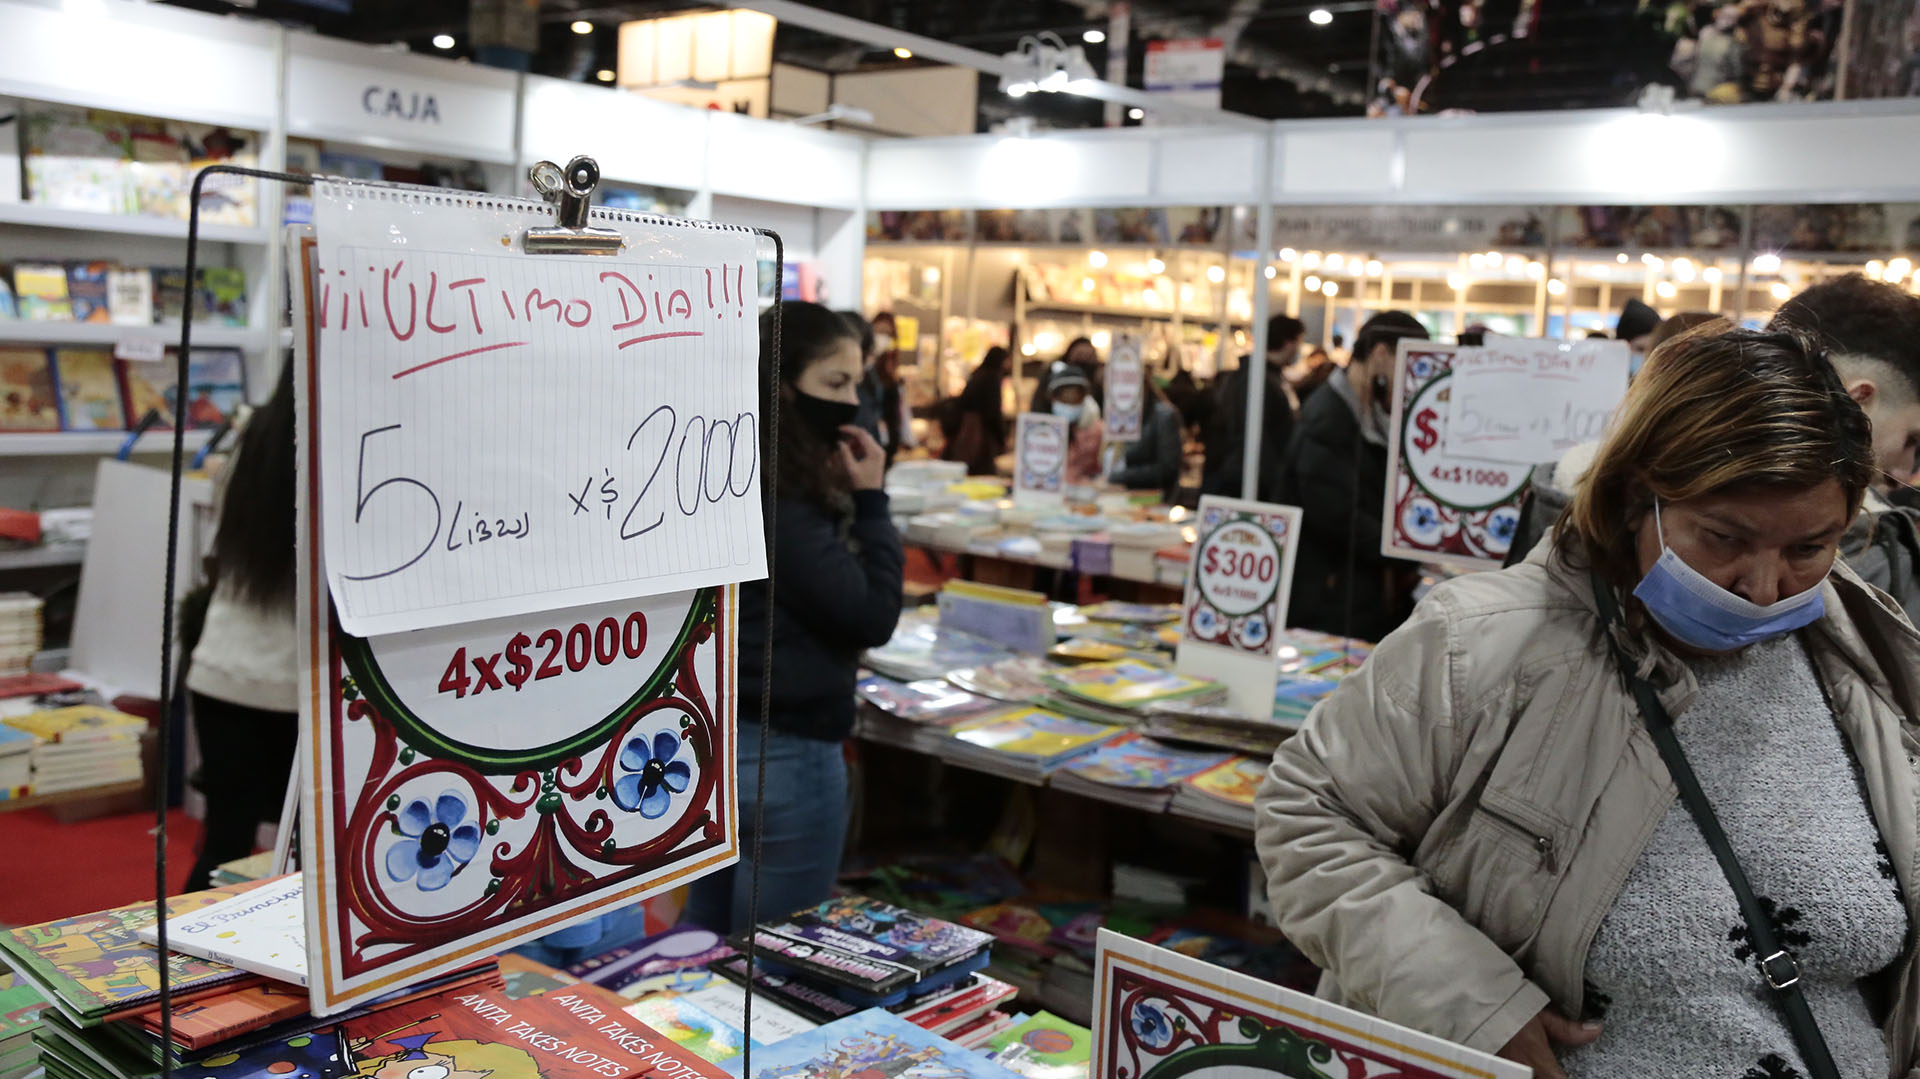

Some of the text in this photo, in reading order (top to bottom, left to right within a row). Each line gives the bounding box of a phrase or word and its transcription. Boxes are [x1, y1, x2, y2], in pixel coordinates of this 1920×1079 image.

[361, 85, 442, 124] CAJA
[341, 424, 441, 580] 5
[1430, 466, 1509, 488] 4x$1000
[1204, 546, 1274, 582] $300
[437, 610, 649, 700] 4x$2000
[453, 994, 631, 1079] ANITA TAKES NOTES
[552, 994, 709, 1079] ANITA TAKES NOTE
